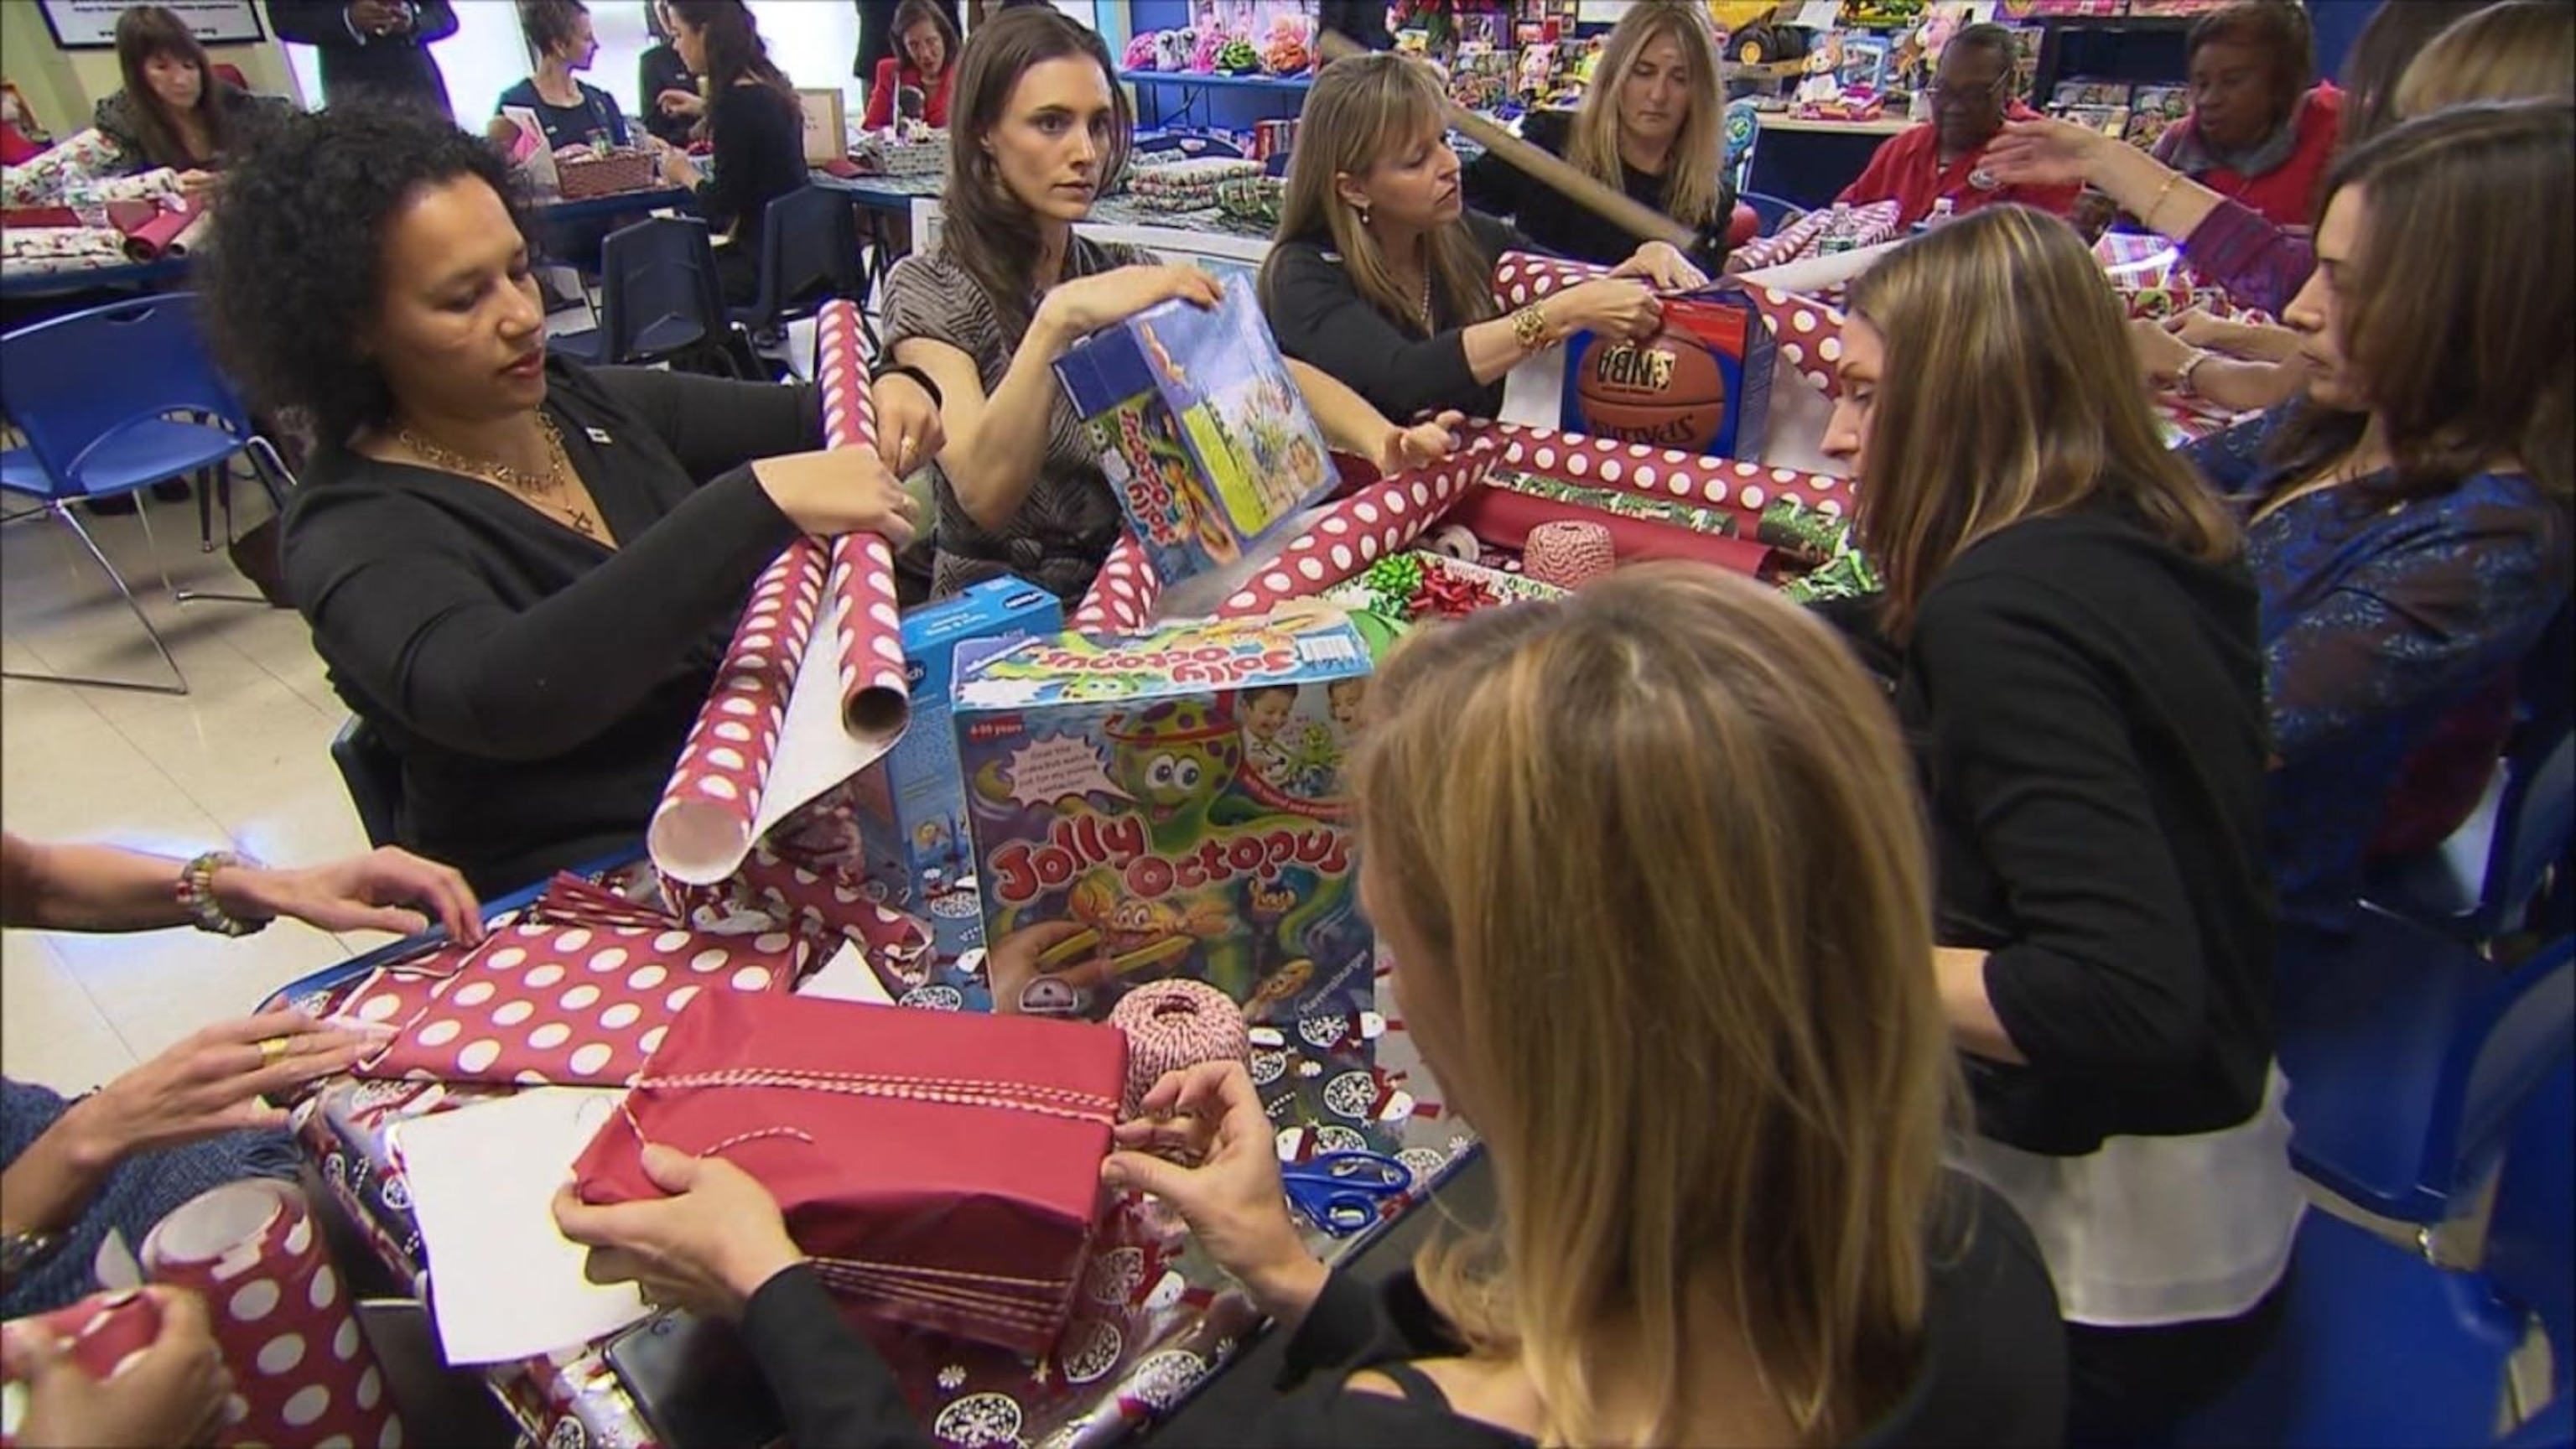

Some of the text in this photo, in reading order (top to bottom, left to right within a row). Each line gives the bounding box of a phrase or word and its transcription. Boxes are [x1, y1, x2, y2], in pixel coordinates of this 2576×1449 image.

[1597, 346, 1654, 387] NBA
[1040, 646, 1230, 669] Octopus
[1173, 650, 1296, 683] Jolly
[994, 812, 1145, 902] Jolly
[1126, 828, 1353, 897] Octopus
